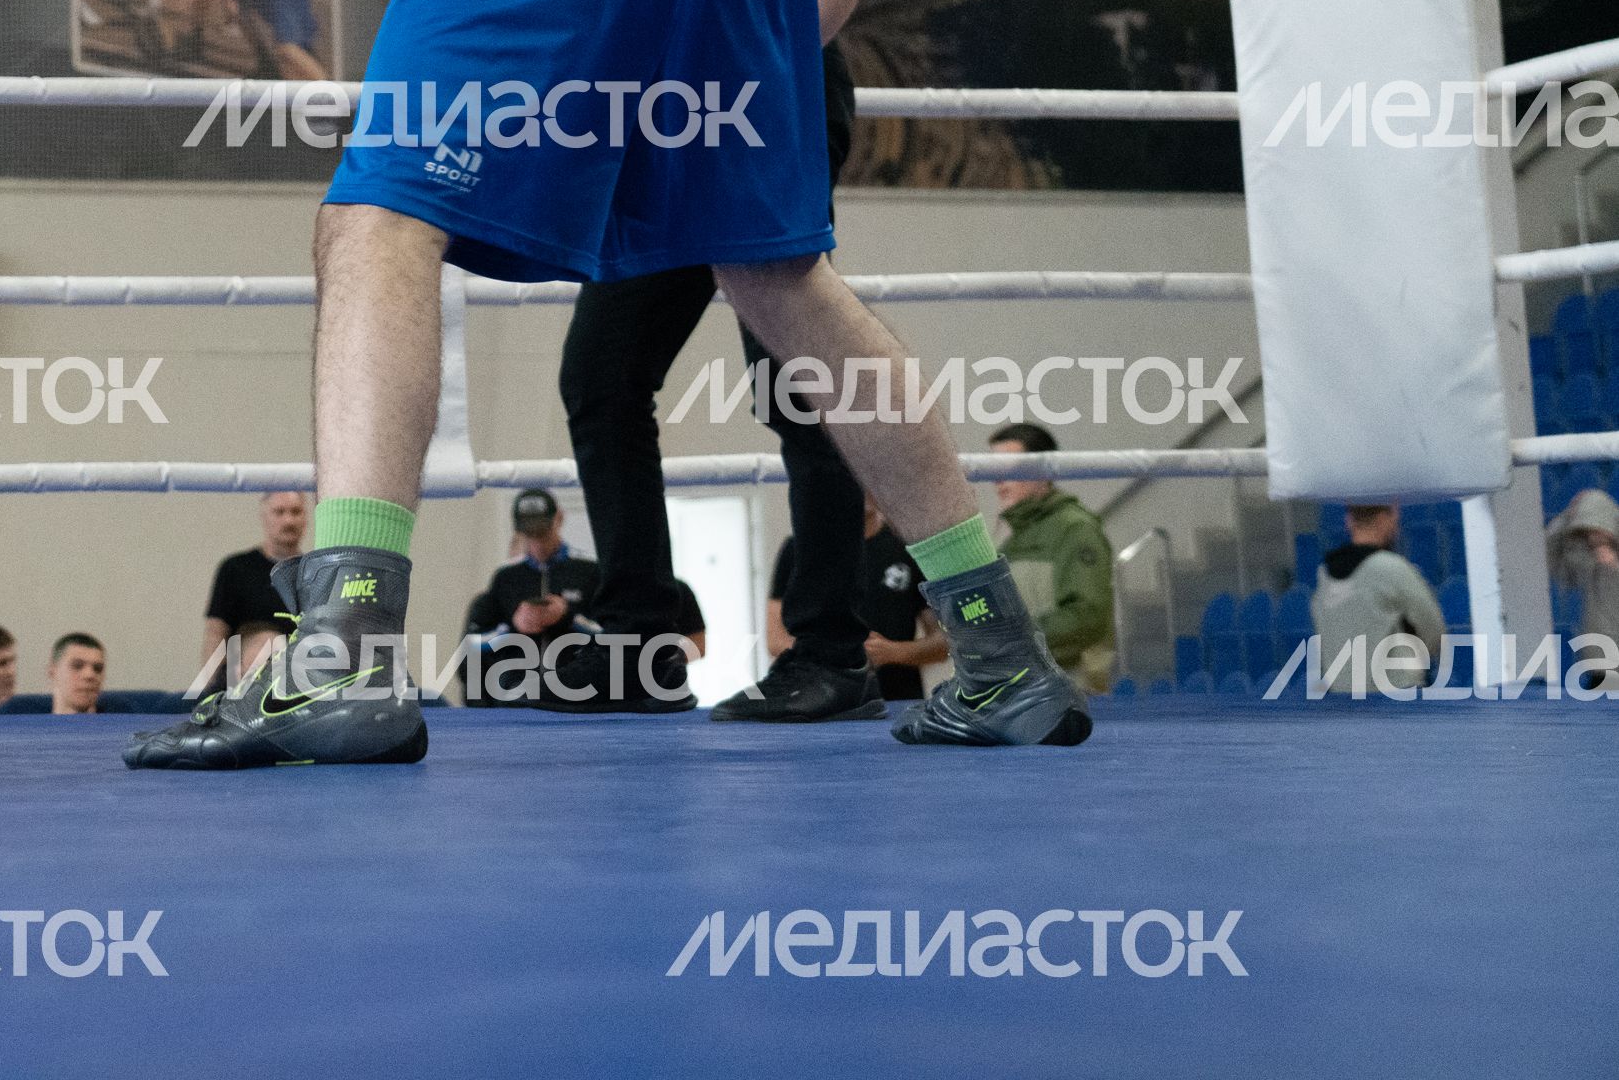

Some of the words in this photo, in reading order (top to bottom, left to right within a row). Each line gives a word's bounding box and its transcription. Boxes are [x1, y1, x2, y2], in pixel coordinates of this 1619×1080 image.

[424, 161, 481, 187] SPORT
[341, 579, 378, 599] NIKE
[960, 597, 989, 622] NIKE
